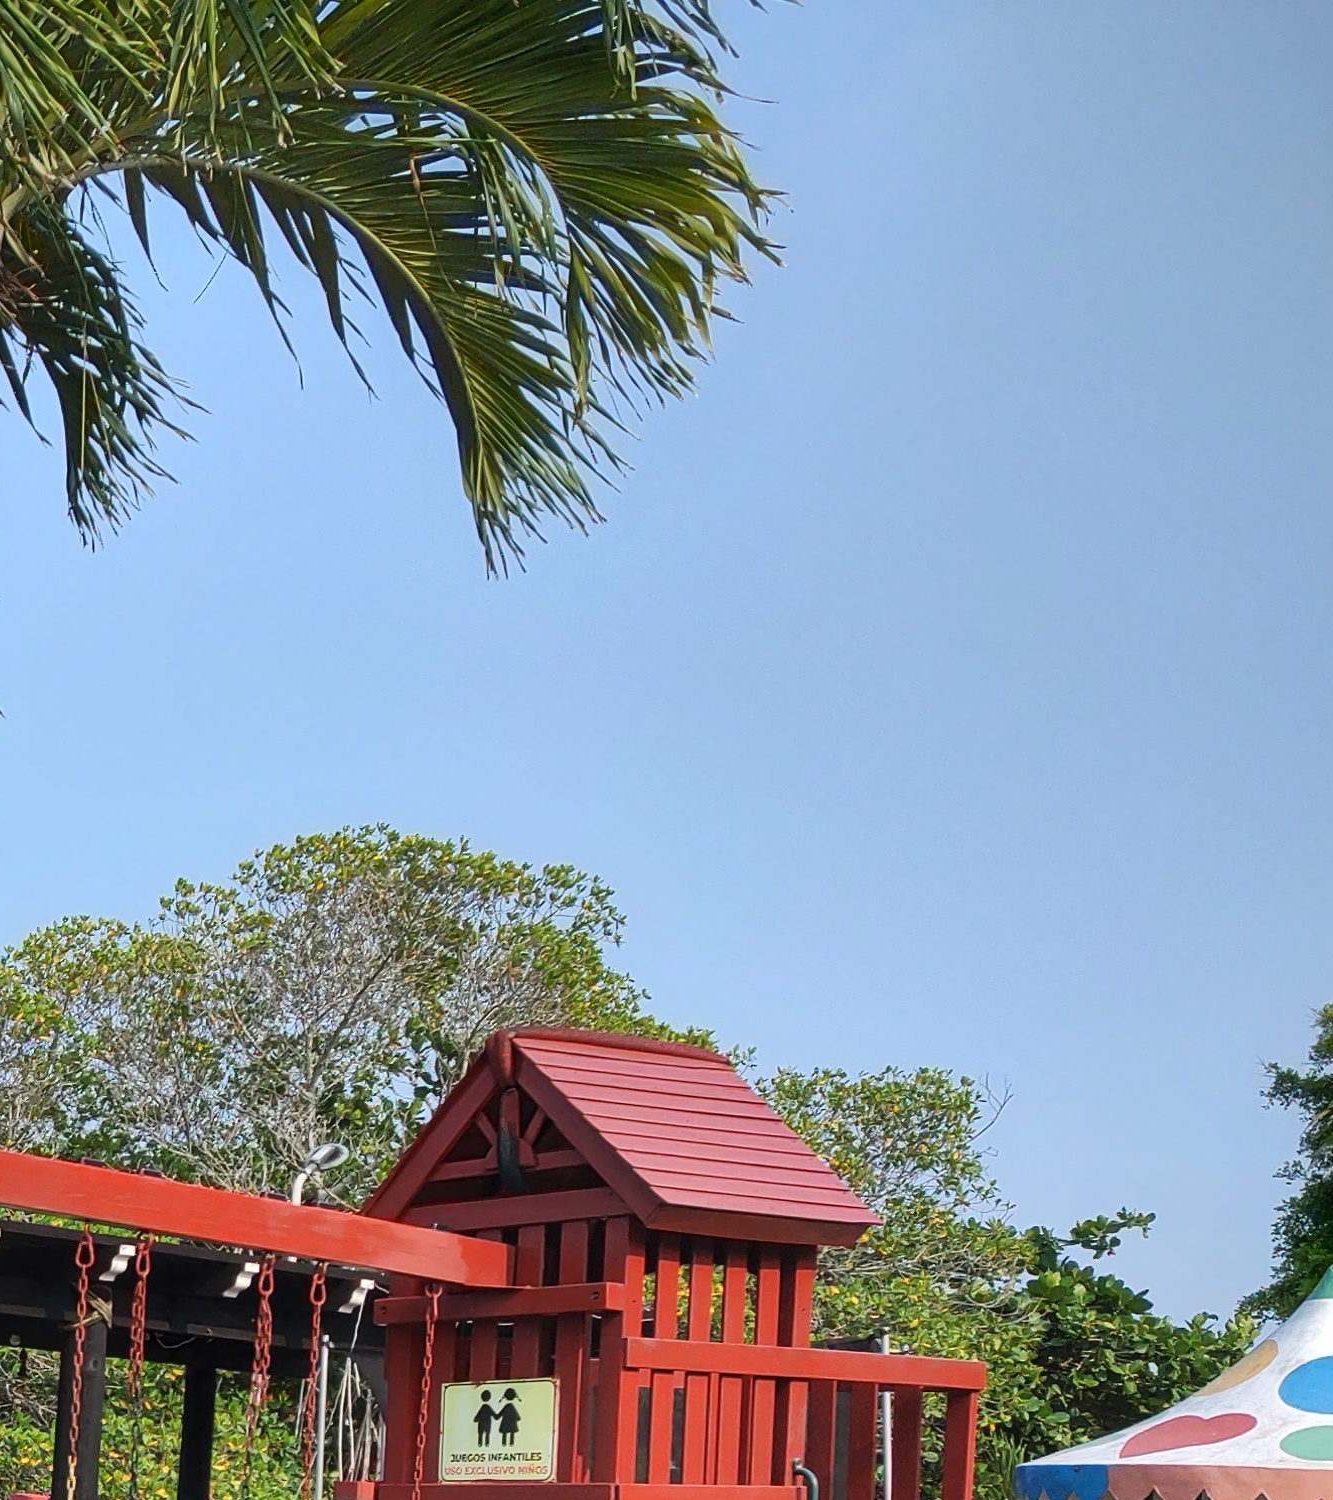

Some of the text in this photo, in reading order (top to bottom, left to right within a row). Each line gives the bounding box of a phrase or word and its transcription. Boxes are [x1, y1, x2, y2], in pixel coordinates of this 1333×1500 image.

[450, 1452, 542, 1463] JUEGOS INFANTILES
[445, 1466, 462, 1475] USO
[465, 1465, 515, 1475] EXCLUSIVO
